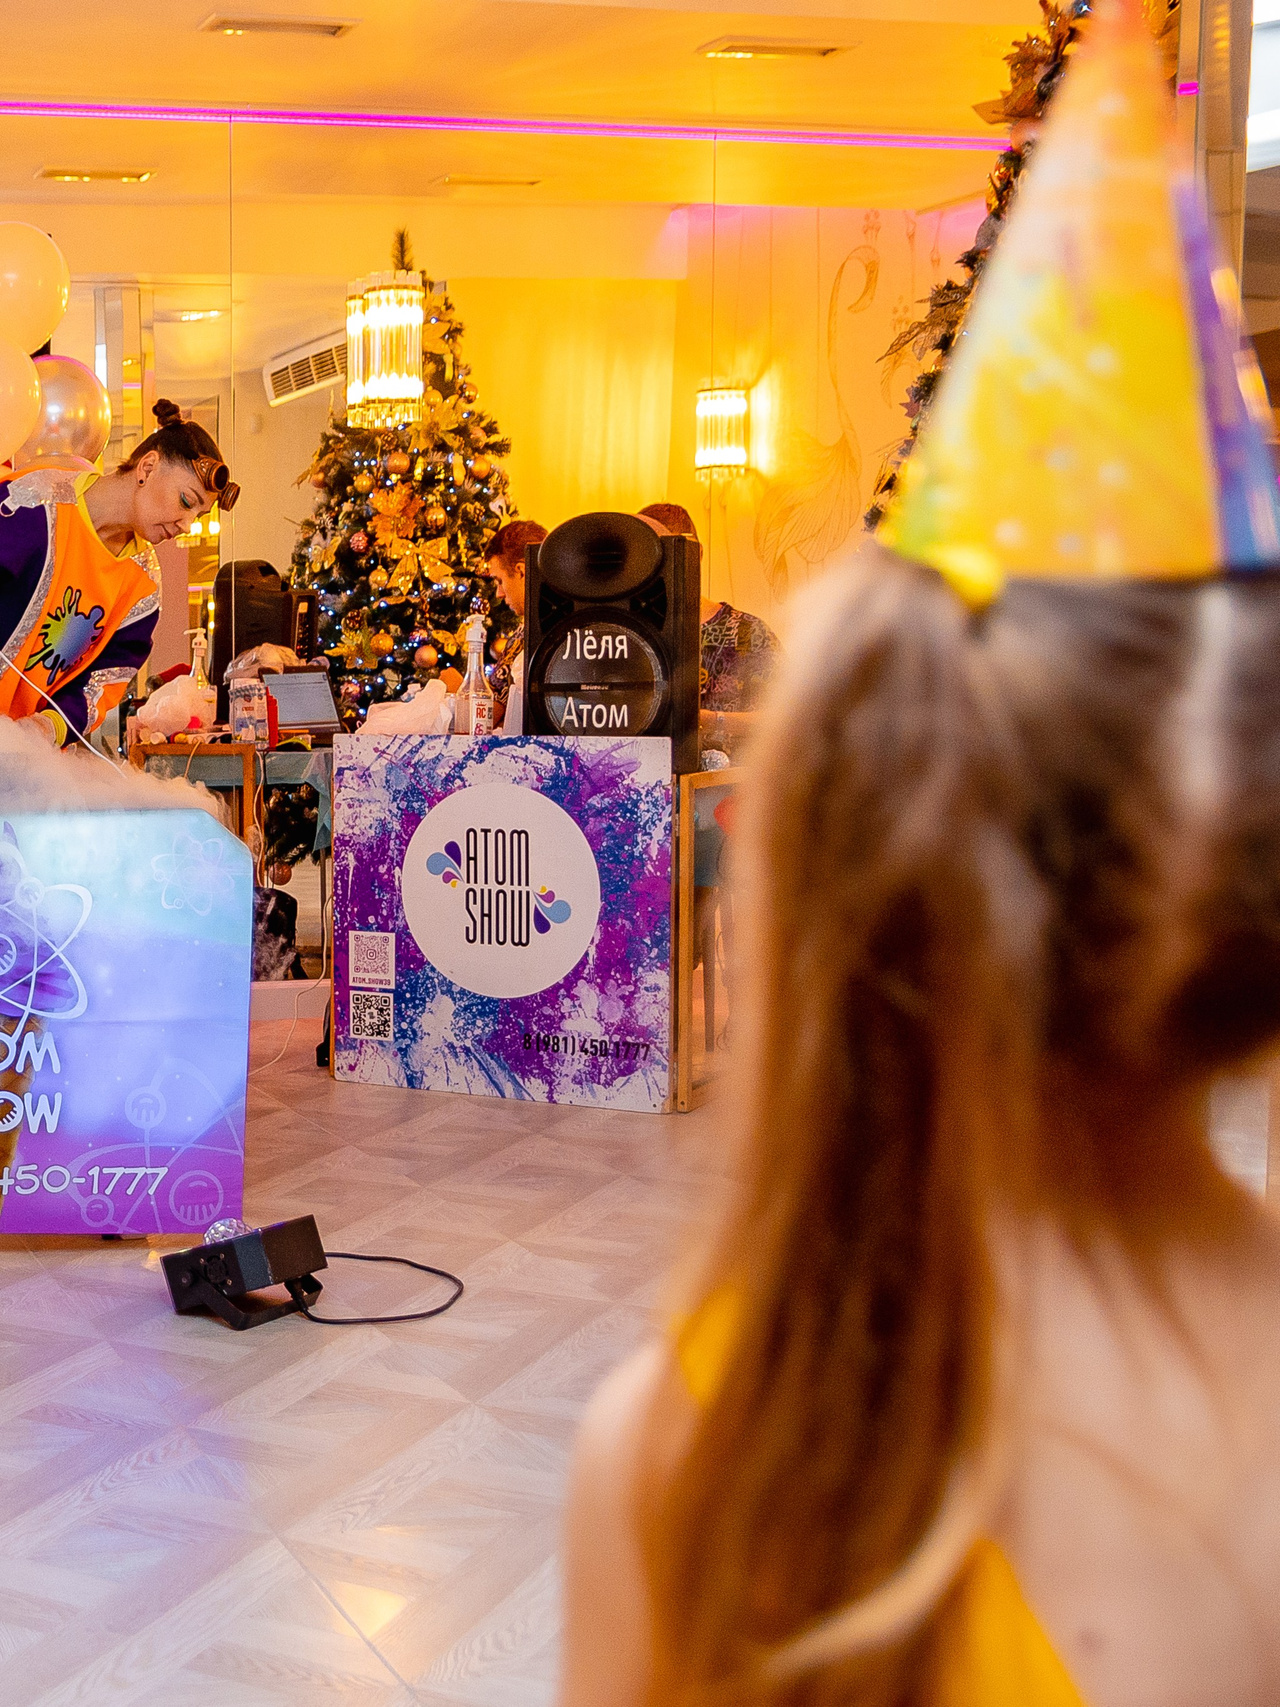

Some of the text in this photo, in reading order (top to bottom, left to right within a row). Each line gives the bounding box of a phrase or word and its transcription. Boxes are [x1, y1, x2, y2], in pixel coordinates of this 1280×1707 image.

[562, 628, 628, 660] Лёля
[465, 827, 530, 887] ATOM
[464, 888, 531, 948] SHOW
[523, 1032, 650, 1061] 8 (981) 450 1777
